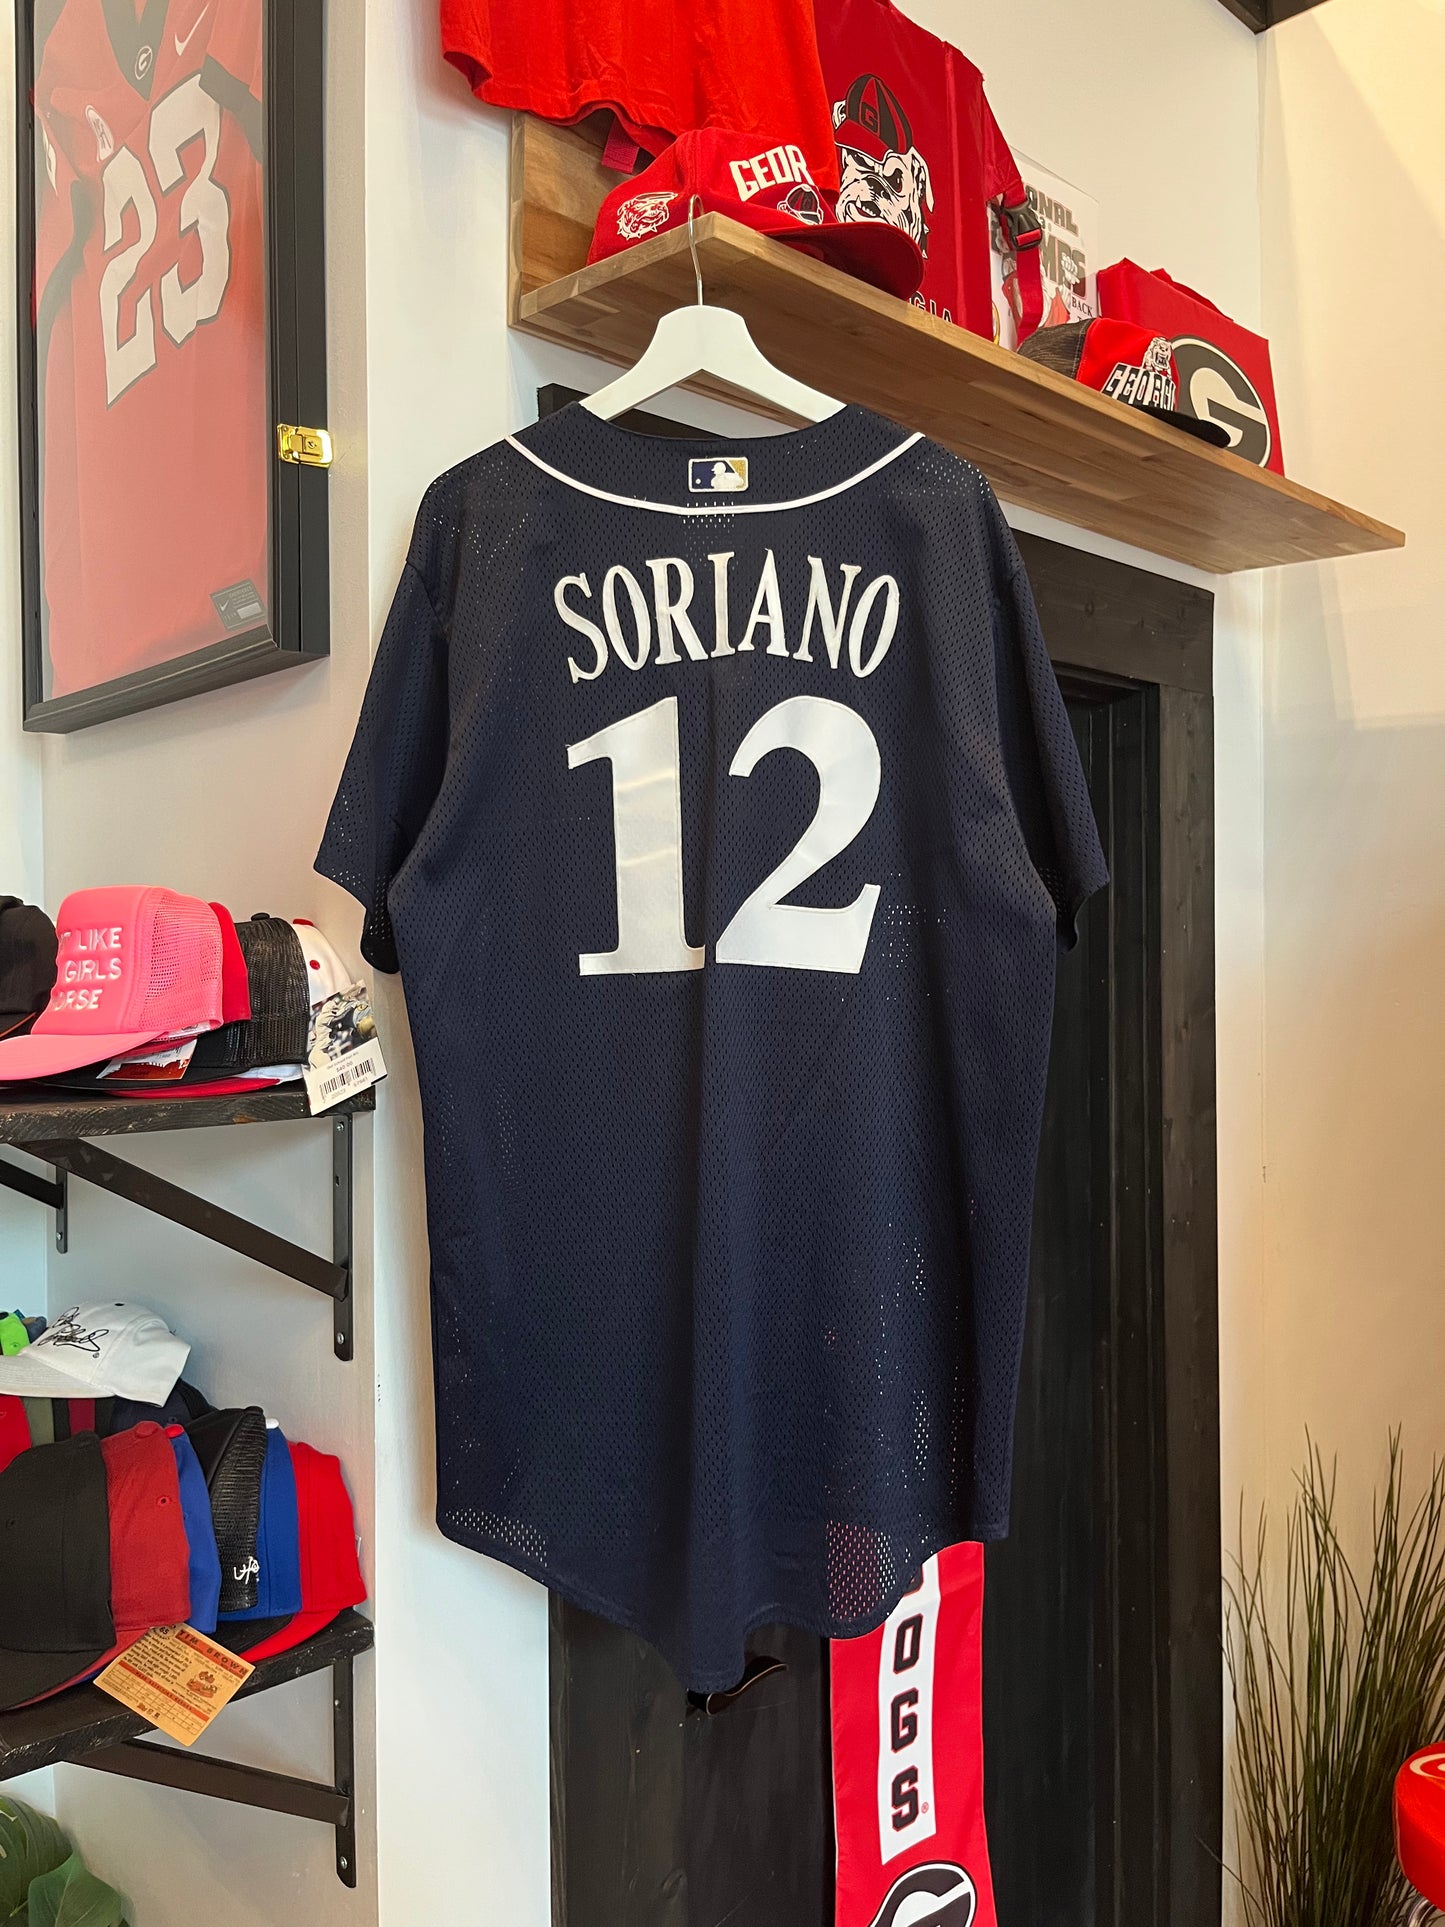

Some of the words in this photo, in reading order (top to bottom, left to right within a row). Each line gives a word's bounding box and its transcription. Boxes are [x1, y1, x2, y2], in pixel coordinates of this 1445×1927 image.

[98, 72, 231, 410] 23
[1071, 295, 1093, 319] BACK
[554, 548, 900, 684] SORIANO
[566, 695, 882, 976] 12
[64, 957, 122, 983] GIRLS
[77, 927, 122, 951] LIKE
[178, 1629, 199, 1646] TIM
[206, 1646, 250, 1676] BROWN
[890, 1562, 925, 1833] OGS
